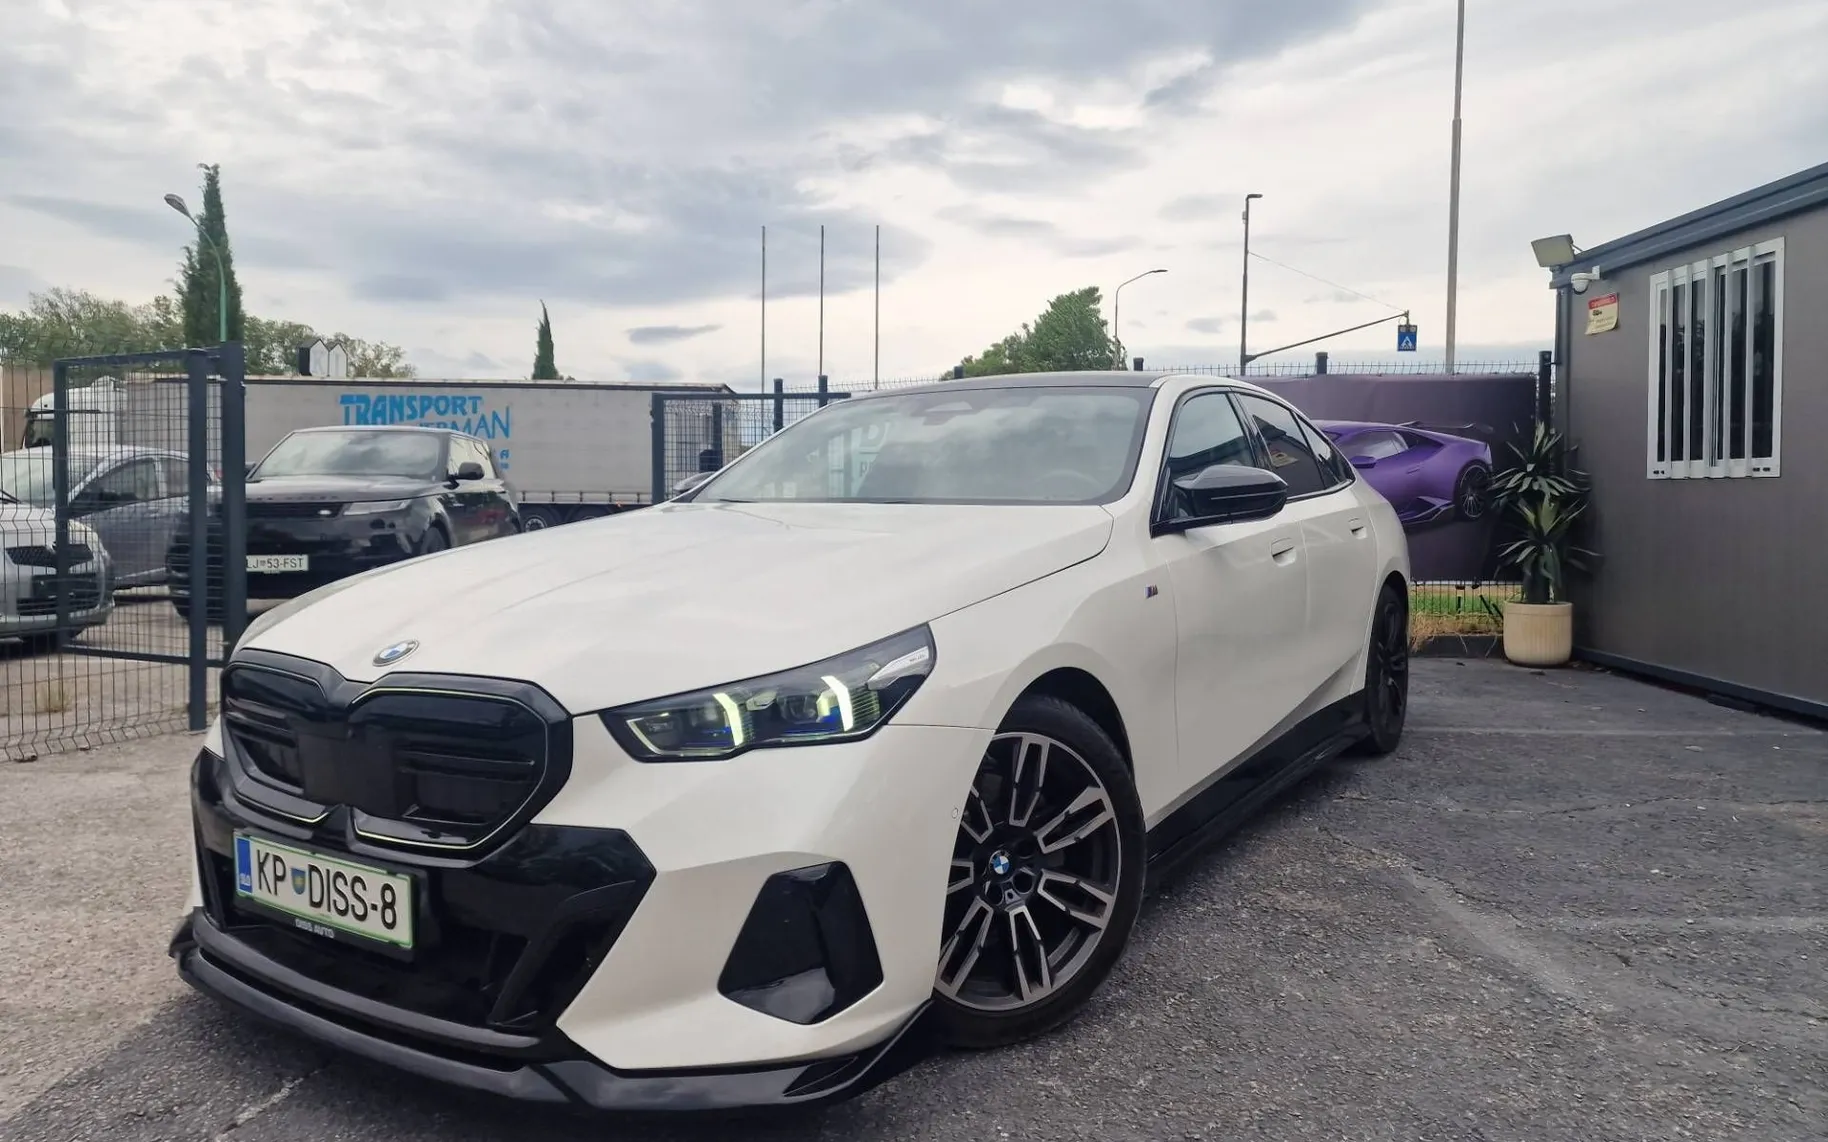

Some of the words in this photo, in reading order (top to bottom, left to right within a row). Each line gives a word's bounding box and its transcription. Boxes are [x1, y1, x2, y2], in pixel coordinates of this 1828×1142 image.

[340, 394, 482, 426] TRANSPORT
[267, 557, 304, 569] 53-FST
[256, 849, 286, 896] KP
[308, 863, 397, 930] DISS-8
